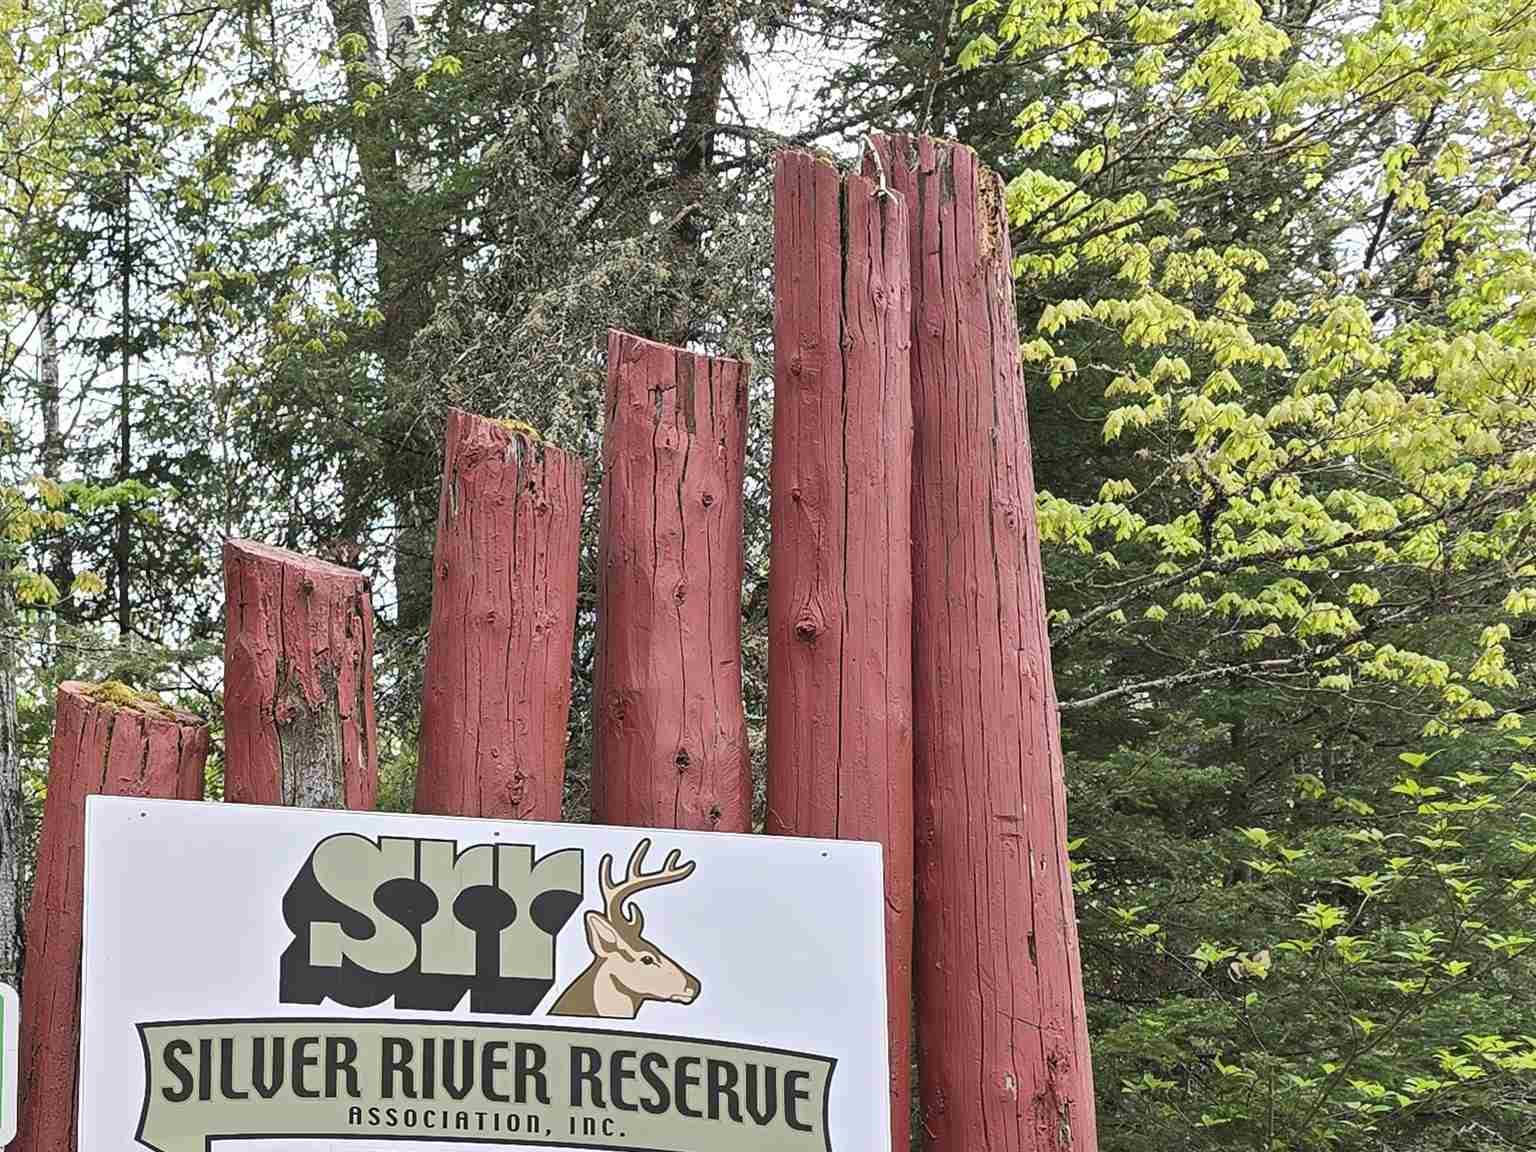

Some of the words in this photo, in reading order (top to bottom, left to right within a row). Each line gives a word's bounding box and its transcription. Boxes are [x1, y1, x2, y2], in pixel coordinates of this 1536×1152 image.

[161, 1035, 361, 1102] SILVER
[380, 1036, 551, 1106] RIVER
[569, 1045, 814, 1132] RESERVE
[348, 1105, 552, 1136] ASSOCIATION,
